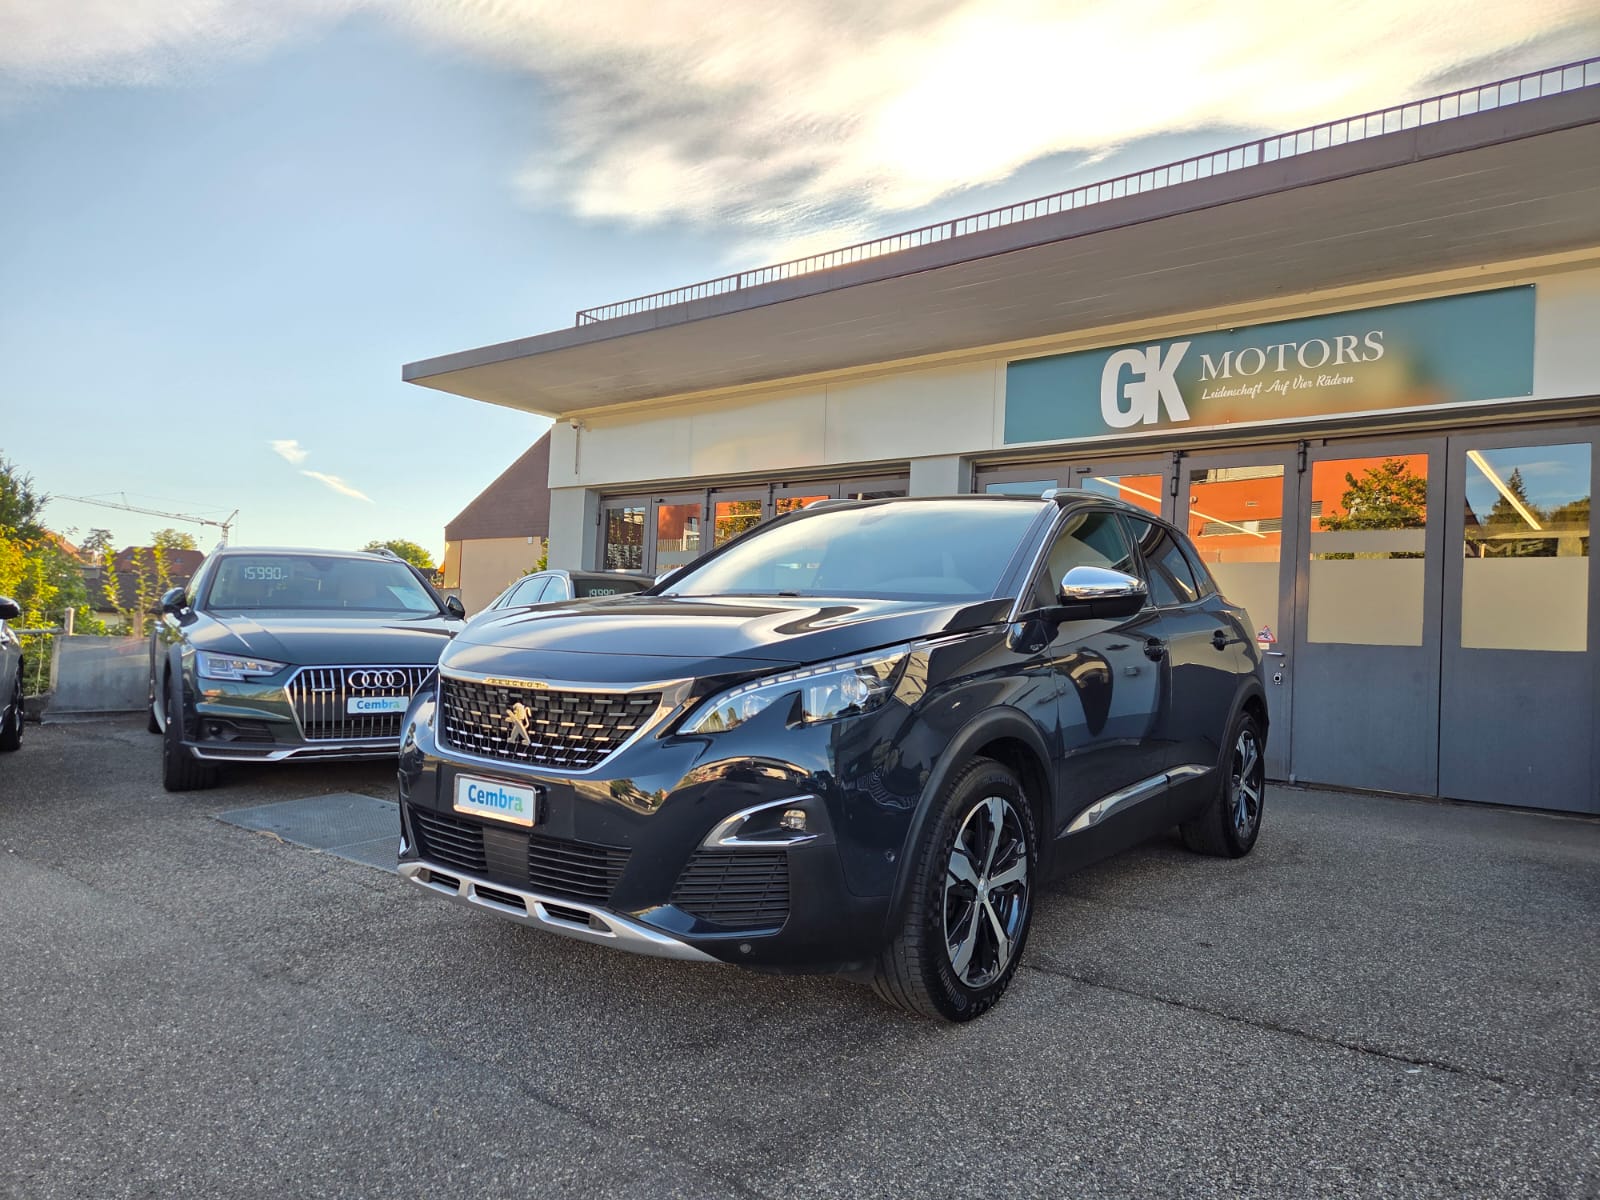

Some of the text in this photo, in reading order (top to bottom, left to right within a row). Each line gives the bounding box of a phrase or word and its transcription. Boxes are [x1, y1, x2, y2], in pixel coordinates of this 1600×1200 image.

[1100, 330, 1386, 429] GK MOTORS
[1201, 374, 1355, 401] Leidenschaft Auf Vier Rädern
[490, 678, 541, 689] PEUGEOT
[356, 699, 401, 710] Cembra
[467, 784, 524, 812] Cembra
